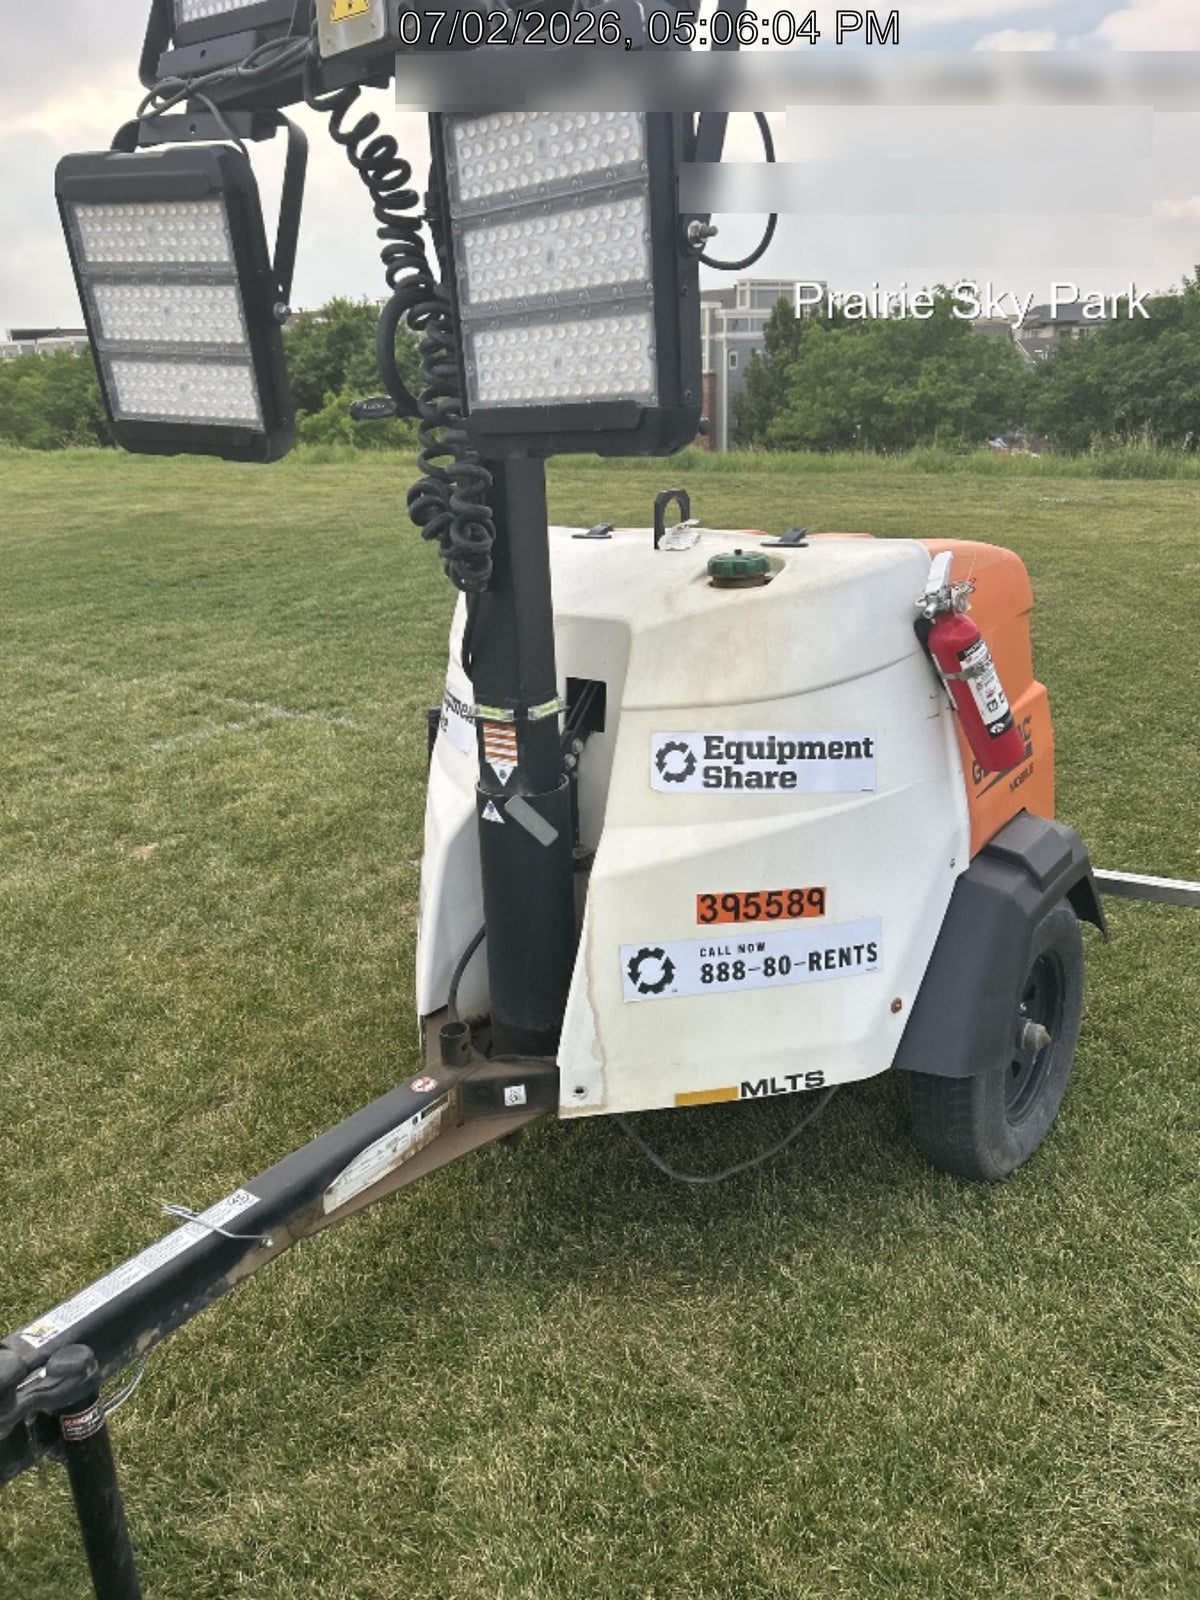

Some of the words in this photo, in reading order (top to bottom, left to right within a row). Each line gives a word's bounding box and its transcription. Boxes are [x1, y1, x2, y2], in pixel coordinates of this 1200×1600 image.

[703, 735, 874, 764] Equipment
[702, 766, 797, 789] Share
[700, 887, 826, 923] 395589
[700, 945, 731, 958] CALL
[737, 941, 766, 954] NOW
[700, 941, 878, 984] 888-80-RENTS
[741, 1070, 826, 1098] MLTS
